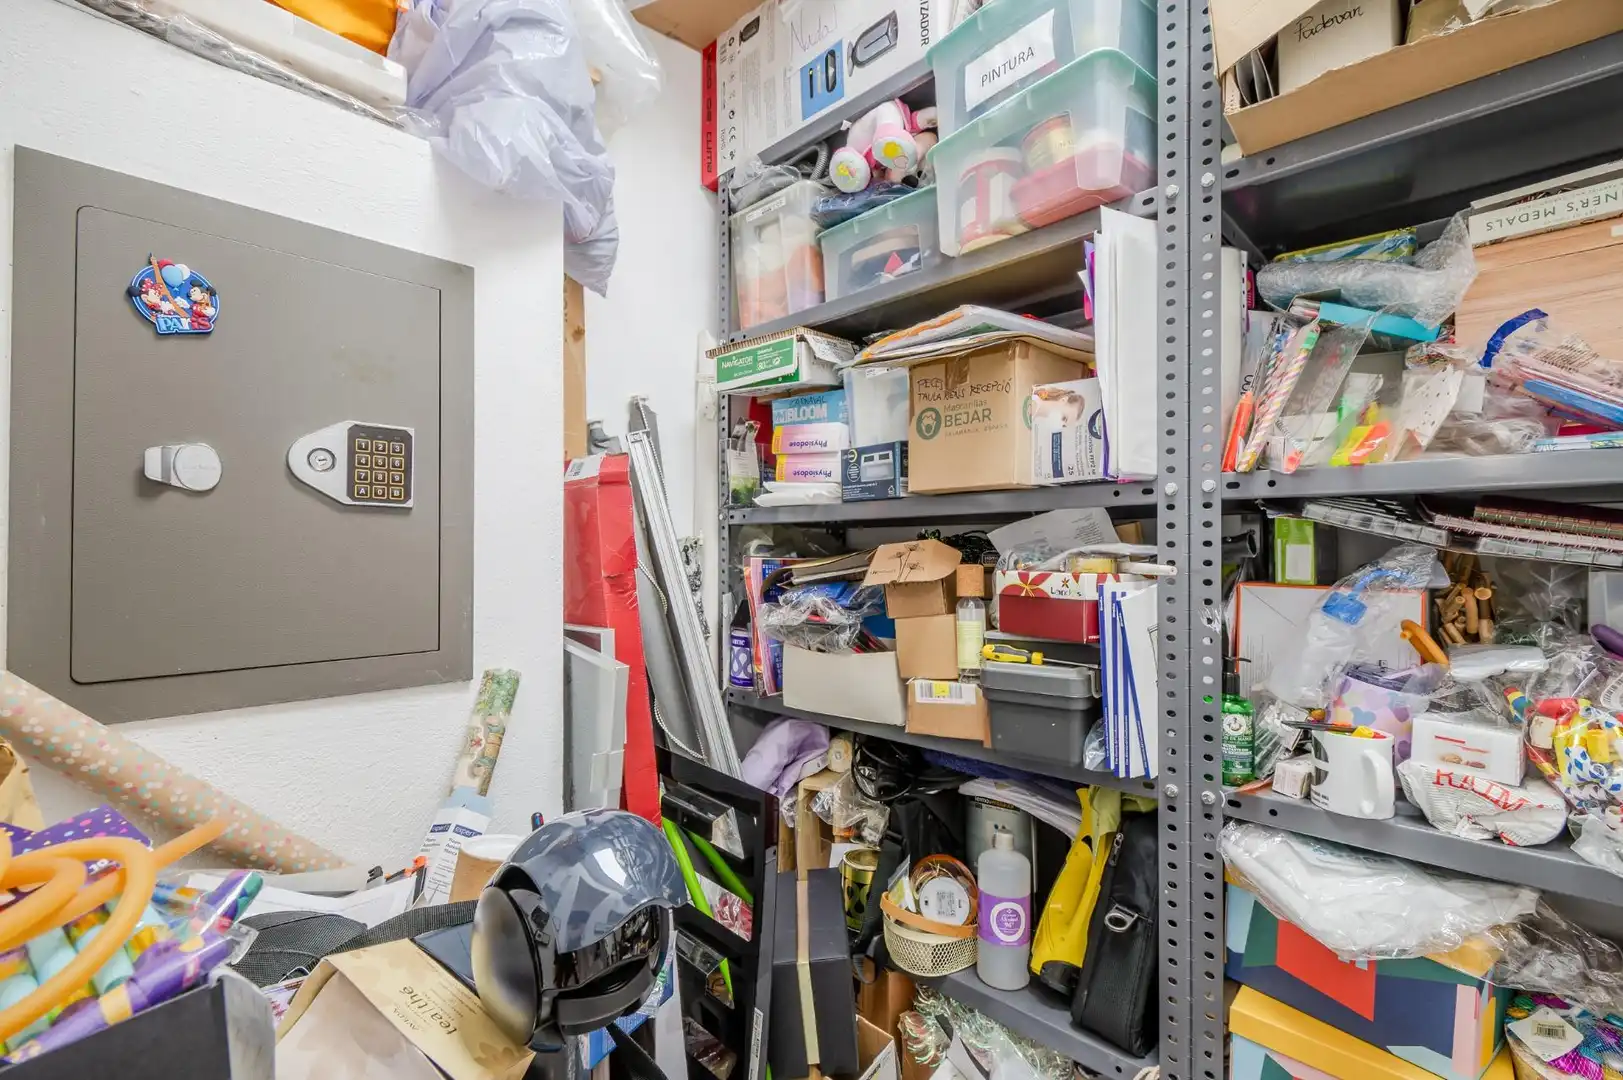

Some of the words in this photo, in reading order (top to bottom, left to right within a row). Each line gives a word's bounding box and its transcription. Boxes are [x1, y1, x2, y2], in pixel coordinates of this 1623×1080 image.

[919, 0, 930, 47] IZADOR
[981, 46, 1035, 87] PINTURA
[1566, 191, 1623, 213] NER'S
[1486, 206, 1556, 231] MEDALS
[158, 316, 211, 330] PARIS
[944, 407, 992, 428] BEJAR
[789, 440, 828, 448] Physiodose
[793, 469, 832, 478] Physiodose
